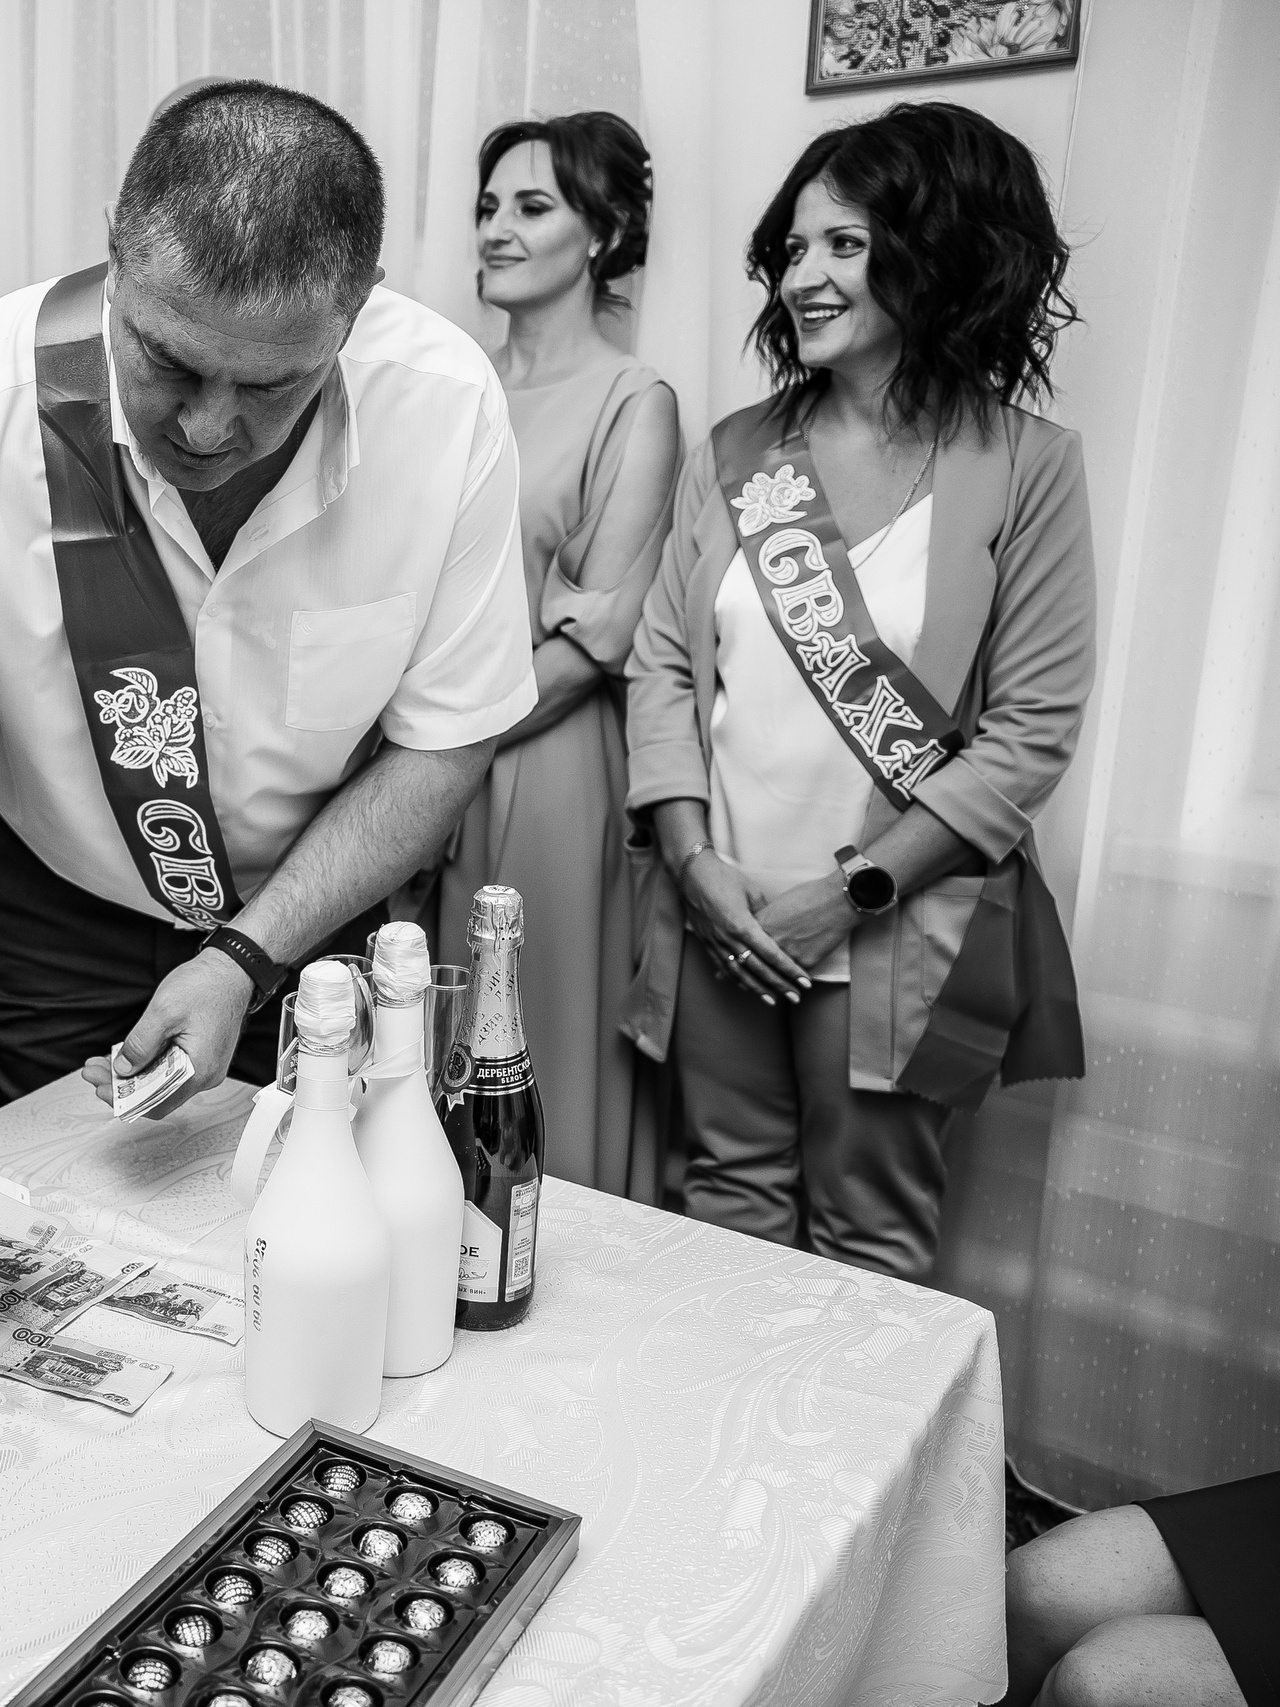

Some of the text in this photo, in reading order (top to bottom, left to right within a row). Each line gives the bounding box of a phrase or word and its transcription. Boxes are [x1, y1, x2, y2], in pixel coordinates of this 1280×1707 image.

[758, 528, 948, 801] СВАХА
[501, 1073, 523, 1084] БЕЛОЕ
[12, 1327, 55, 1349] 100
